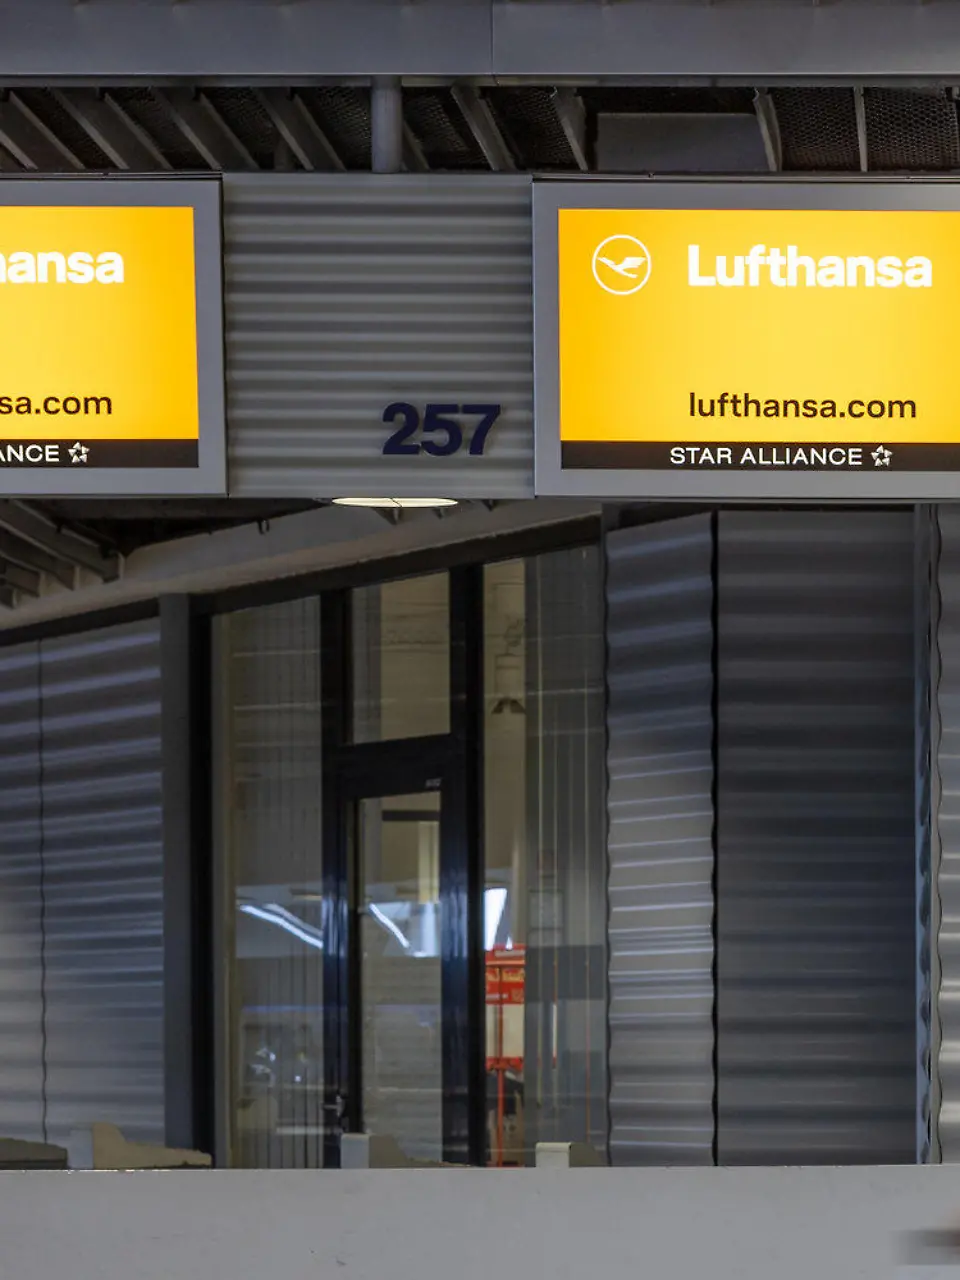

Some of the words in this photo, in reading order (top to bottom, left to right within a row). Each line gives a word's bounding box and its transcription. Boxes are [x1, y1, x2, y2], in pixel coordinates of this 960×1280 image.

[0, 251, 124, 284] ansa
[688, 244, 933, 288] Lufthansa
[689, 391, 917, 418] lufthansa.com
[382, 402, 501, 456] 257
[670, 447, 732, 465] STAR
[740, 447, 863, 465] ALLIANCE
